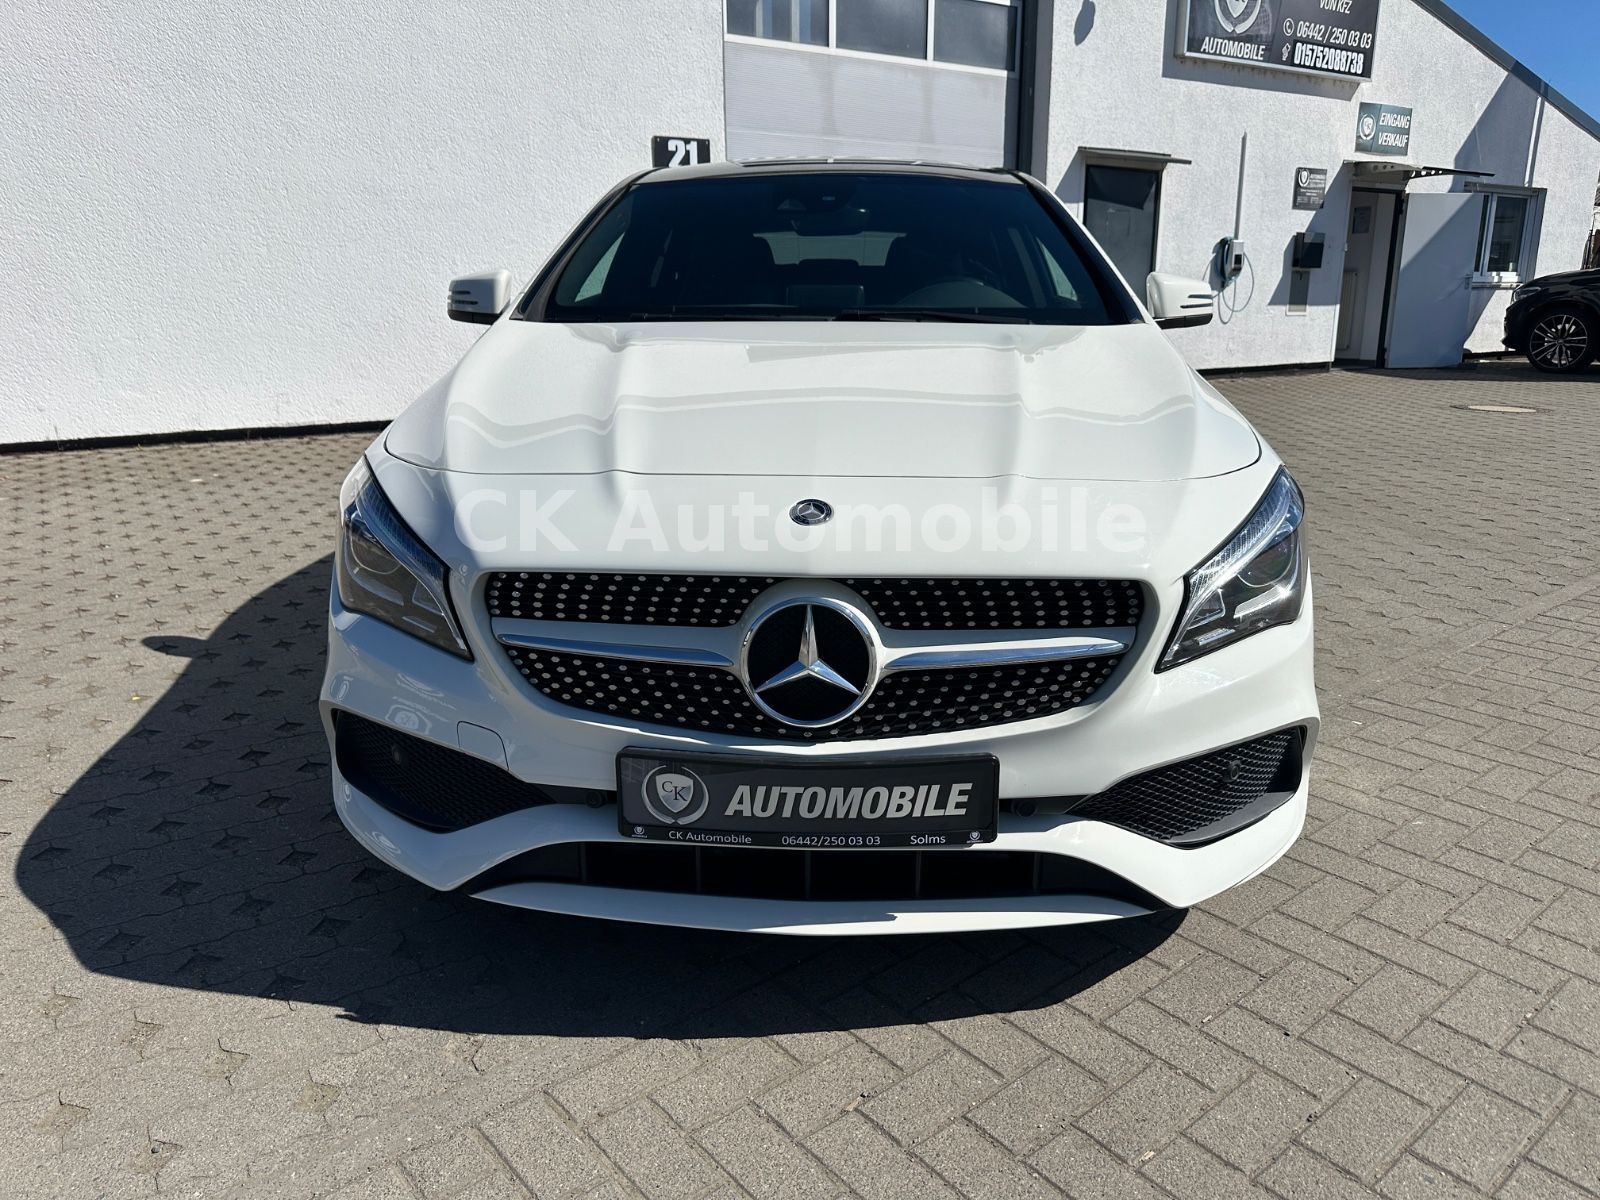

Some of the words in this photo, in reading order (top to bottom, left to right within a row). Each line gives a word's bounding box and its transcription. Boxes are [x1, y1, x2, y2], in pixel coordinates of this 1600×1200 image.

[1336, 0, 1352, 14] KFZ
[1296, 20, 1325, 41] 06442
[1330, 27, 1348, 45] 250
[1348, 30, 1360, 47] 03
[1360, 32, 1372, 49] 03
[1200, 36, 1266, 60] AUTOMOBILE
[1294, 42, 1364, 74] 015752088738
[1380, 112, 1410, 129] EINGANG
[1378, 132, 1409, 148] VERKAUF
[667, 139, 698, 168] 21
[661, 780, 688, 802] CK
[724, 782, 973, 819] AUTOMOBILE
[668, 830, 683, 840] CK
[686, 831, 752, 844] Automobile
[782, 835, 846, 847] 06442/250
[848, 836, 863, 846] 03
[866, 836, 881, 846] 03
[910, 835, 946, 845] Solms
